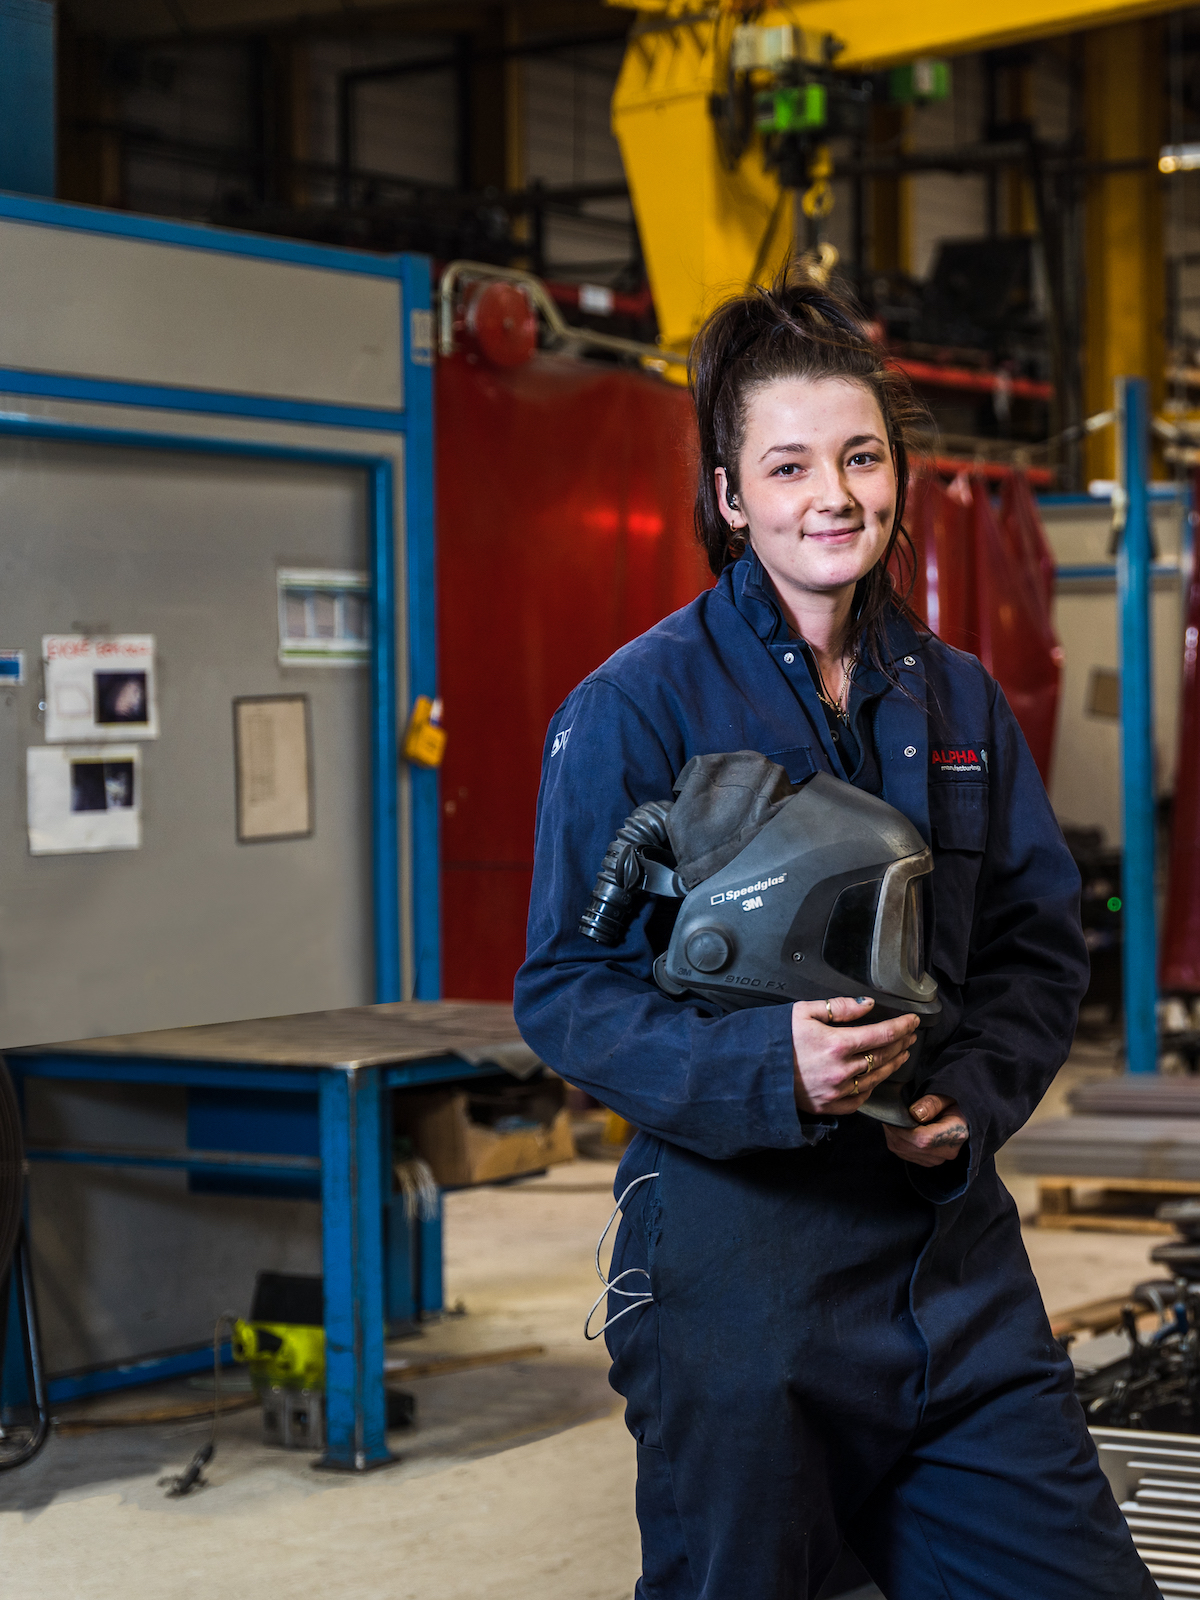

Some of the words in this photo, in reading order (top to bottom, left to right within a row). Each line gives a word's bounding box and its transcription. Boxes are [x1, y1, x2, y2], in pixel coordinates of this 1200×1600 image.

[932, 749, 979, 764] ALPHA
[742, 896, 763, 912] 3M
[677, 967, 692, 977] 3M
[724, 974, 761, 987] 9100
[765, 981, 787, 991] FX
